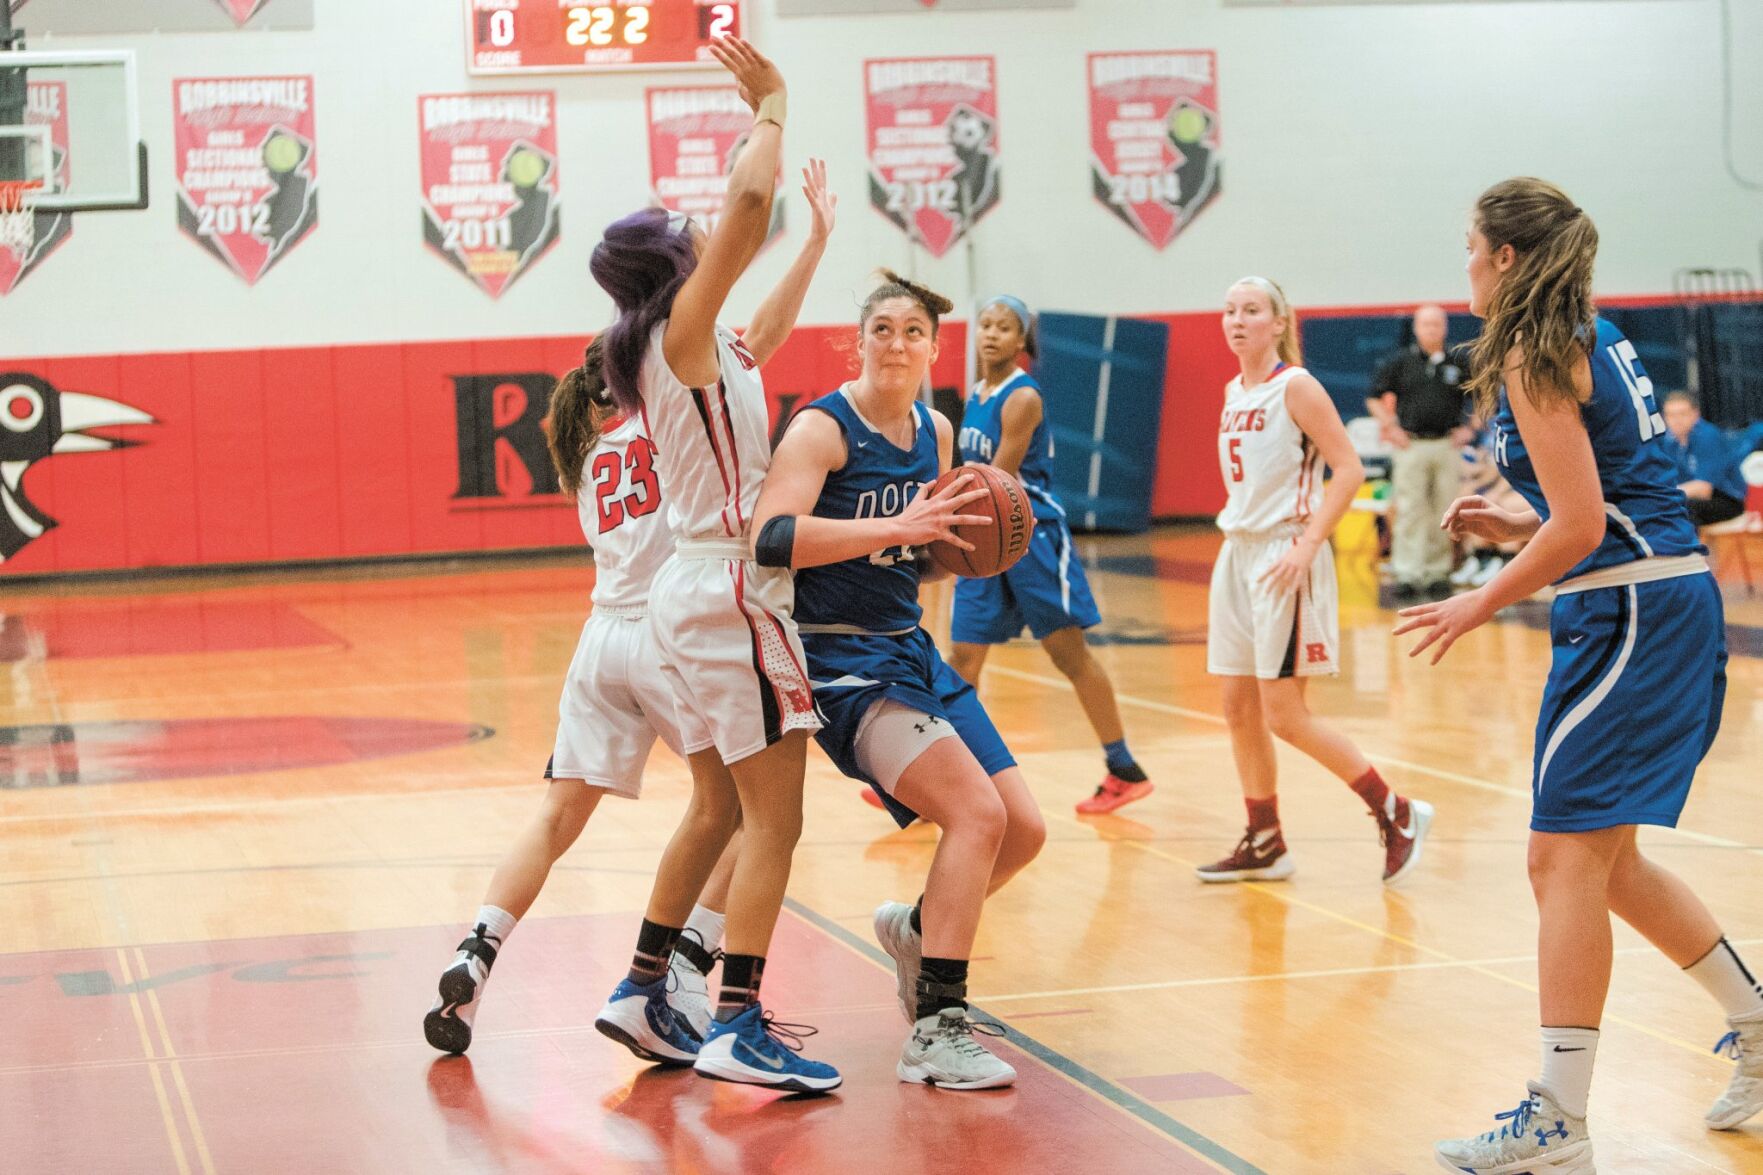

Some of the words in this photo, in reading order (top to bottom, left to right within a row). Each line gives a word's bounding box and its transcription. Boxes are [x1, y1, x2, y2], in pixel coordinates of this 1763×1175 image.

[490, 9, 515, 47] 0
[566, 7, 615, 46] 22
[624, 6, 650, 45] 2
[196, 203, 272, 236] 2012
[441, 217, 512, 250] 2011
[1229, 438, 1245, 482] 5
[592, 434, 662, 536] 23
[1306, 642, 1329, 664] R
